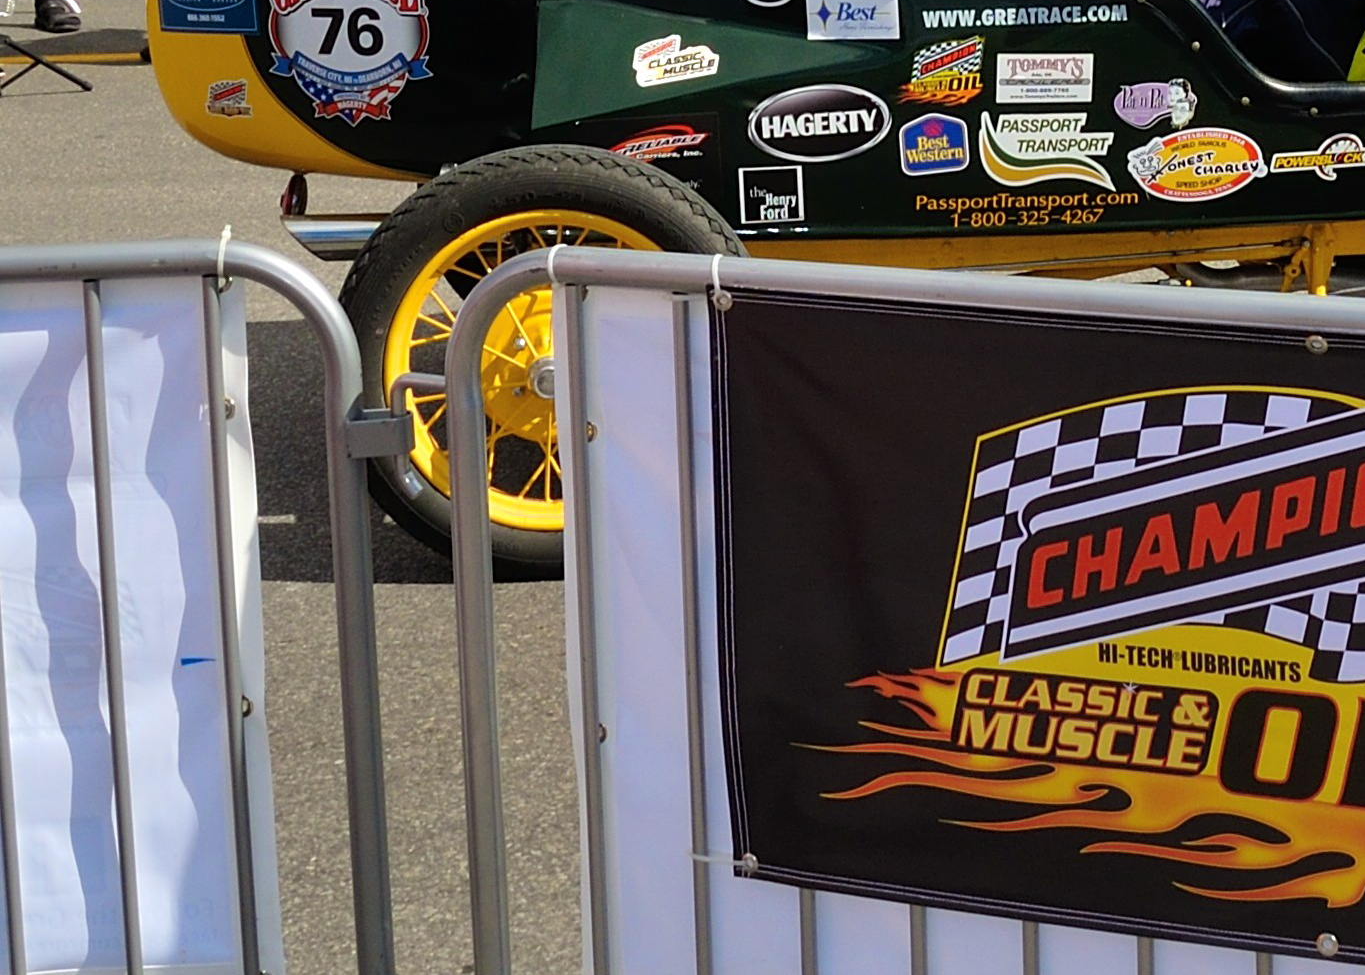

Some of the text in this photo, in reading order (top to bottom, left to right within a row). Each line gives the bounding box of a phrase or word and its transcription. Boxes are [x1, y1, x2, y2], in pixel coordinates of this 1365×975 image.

[836, 1, 877, 22] Best
[922, 5, 1128, 29] WWW.GREATRACE.COM
[311, 7, 384, 56] 76
[648, 51, 701, 69] CLASSIC
[662, 58, 716, 76] MUSCLE
[921, 42, 977, 75] CHAMPION
[1007, 57, 1084, 79] TOMMY'S
[948, 75, 983, 92] OIL
[761, 108, 878, 139] HAGERTY
[1000, 118, 1083, 134] PASSPORT
[623, 134, 699, 155] RELIABLE
[916, 135, 950, 151] Best
[1017, 137, 1109, 154] TRANSPORT
[906, 145, 965, 164] Western
[1194, 161, 1260, 177] CHARLEY
[750, 185, 767, 198] the
[765, 192, 797, 208] Henry
[760, 203, 789, 220] Ford
[915, 192, 1139, 213] PassportTransport.com
[950, 207, 1105, 228] 1-800-325-4267
[1181, 650, 1302, 683] LUBRICANTS
[964, 671, 1163, 723] CLASSIC
[958, 708, 1208, 772] MUSCLE
